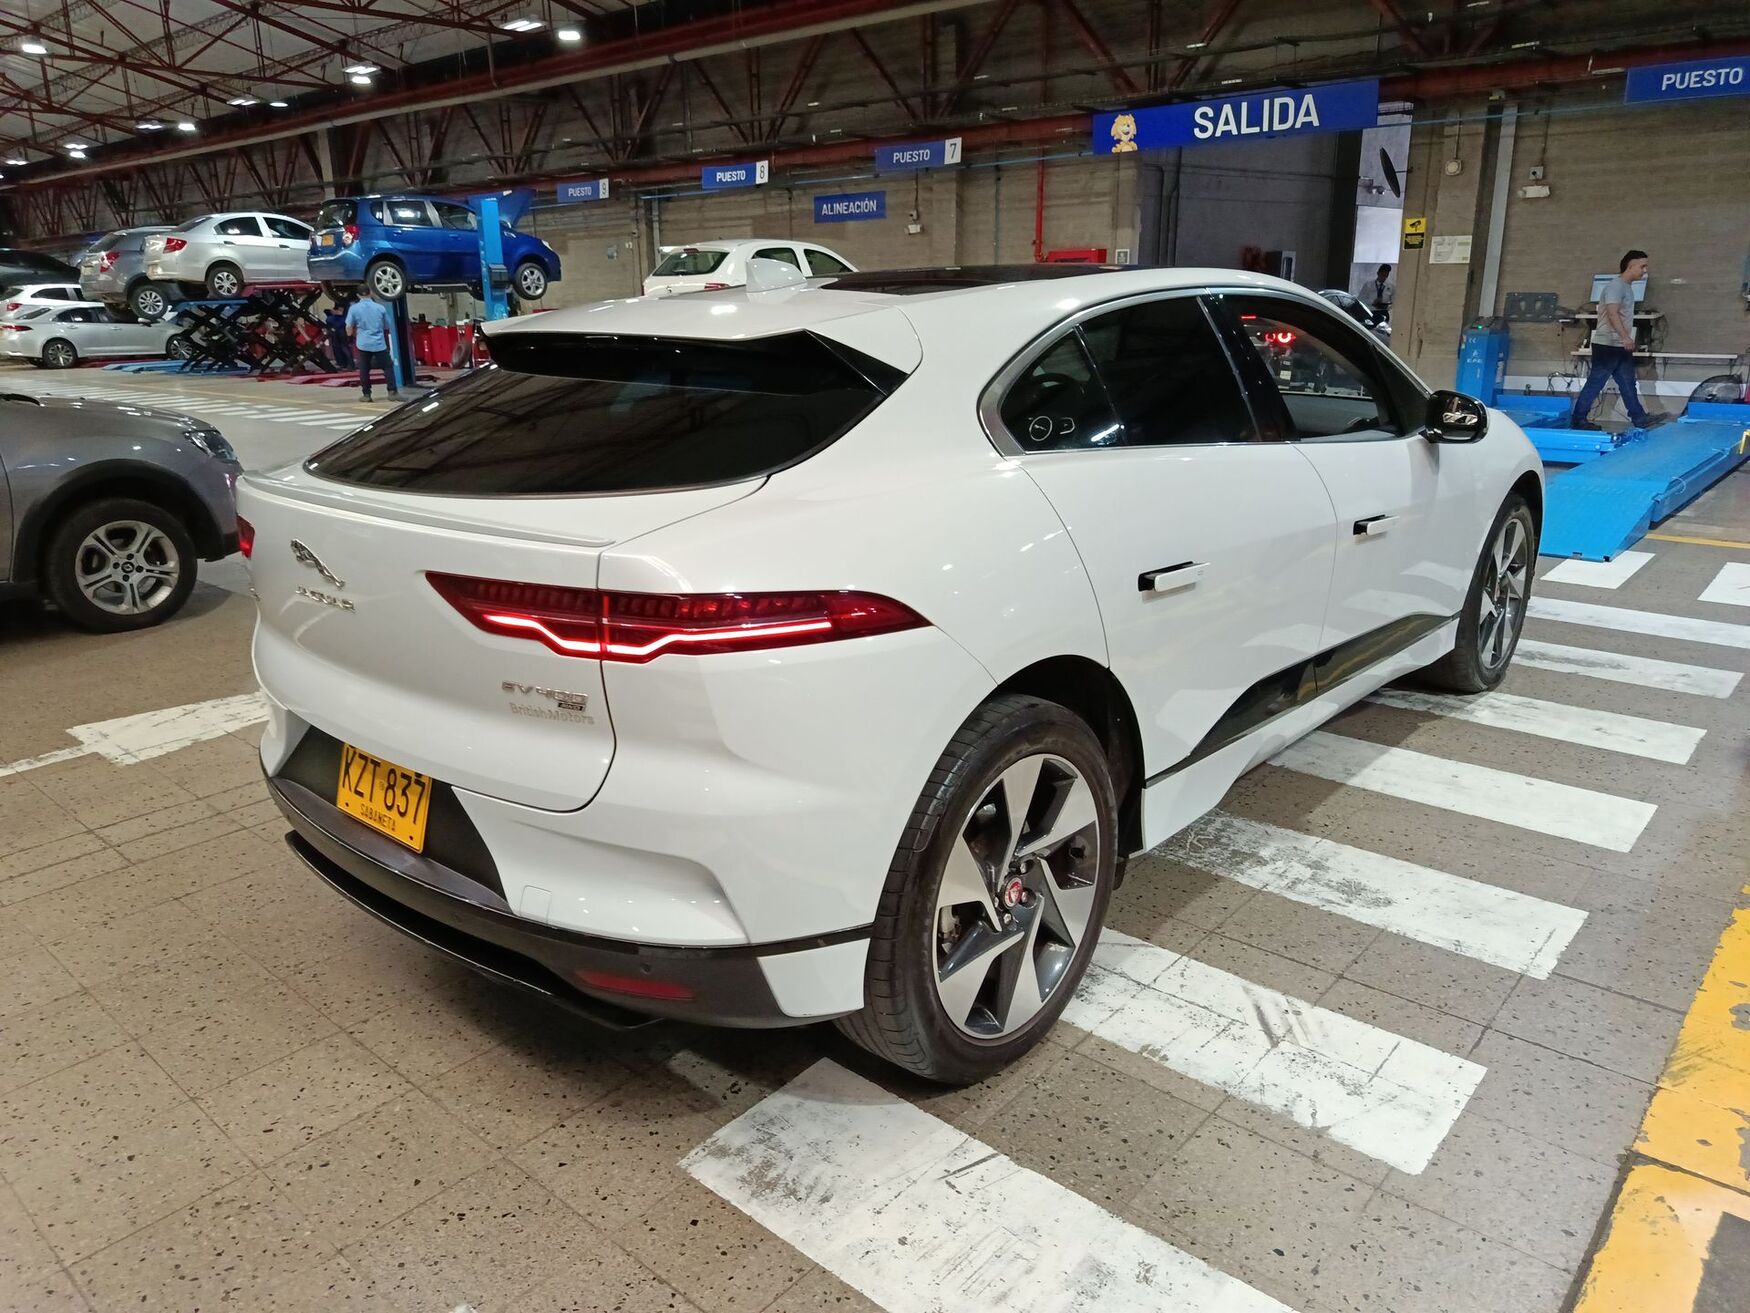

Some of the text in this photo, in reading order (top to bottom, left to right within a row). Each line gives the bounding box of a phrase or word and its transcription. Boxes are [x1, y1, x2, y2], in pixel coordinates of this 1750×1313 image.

[1661, 67, 1744, 91] PUESTO
[1193, 93, 1320, 139] SALIDA
[892, 142, 957, 164] PUESTO 7
[716, 164, 765, 183] PUESTO 8
[567, 182, 607, 197] PUESTO 9
[821, 197, 877, 216] ALINEACIÓN
[342, 746, 426, 826] KZT 837
